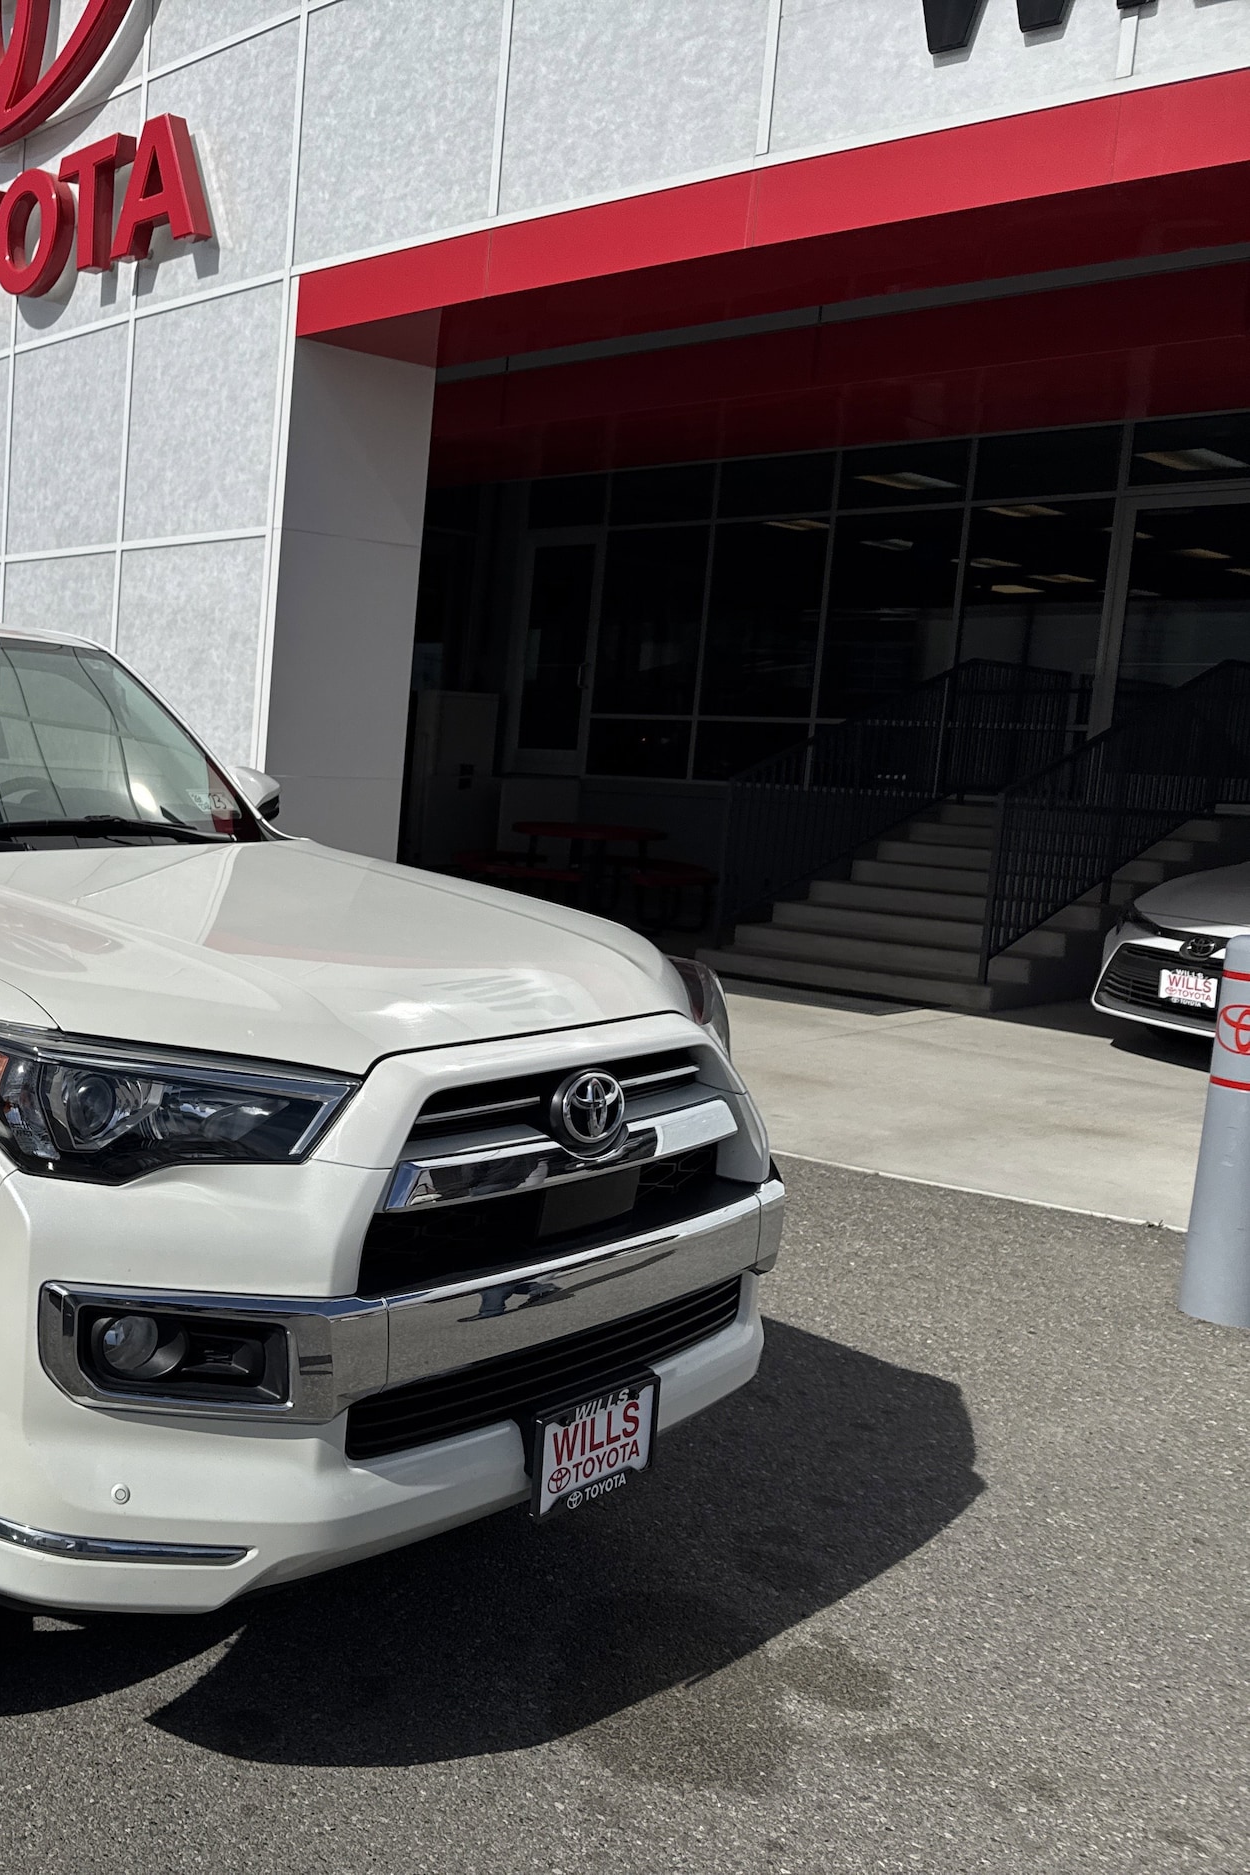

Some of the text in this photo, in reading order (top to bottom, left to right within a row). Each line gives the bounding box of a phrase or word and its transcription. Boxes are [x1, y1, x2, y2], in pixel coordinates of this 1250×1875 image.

[1168, 974, 1212, 993] WILLS
[1177, 989, 1212, 1002] TOYOTA
[575, 1388, 630, 1421] WILLS
[553, 1401, 640, 1467] WILLS
[572, 1439, 640, 1483] TOYOTA
[584, 1473, 627, 1501] TOYOTA
